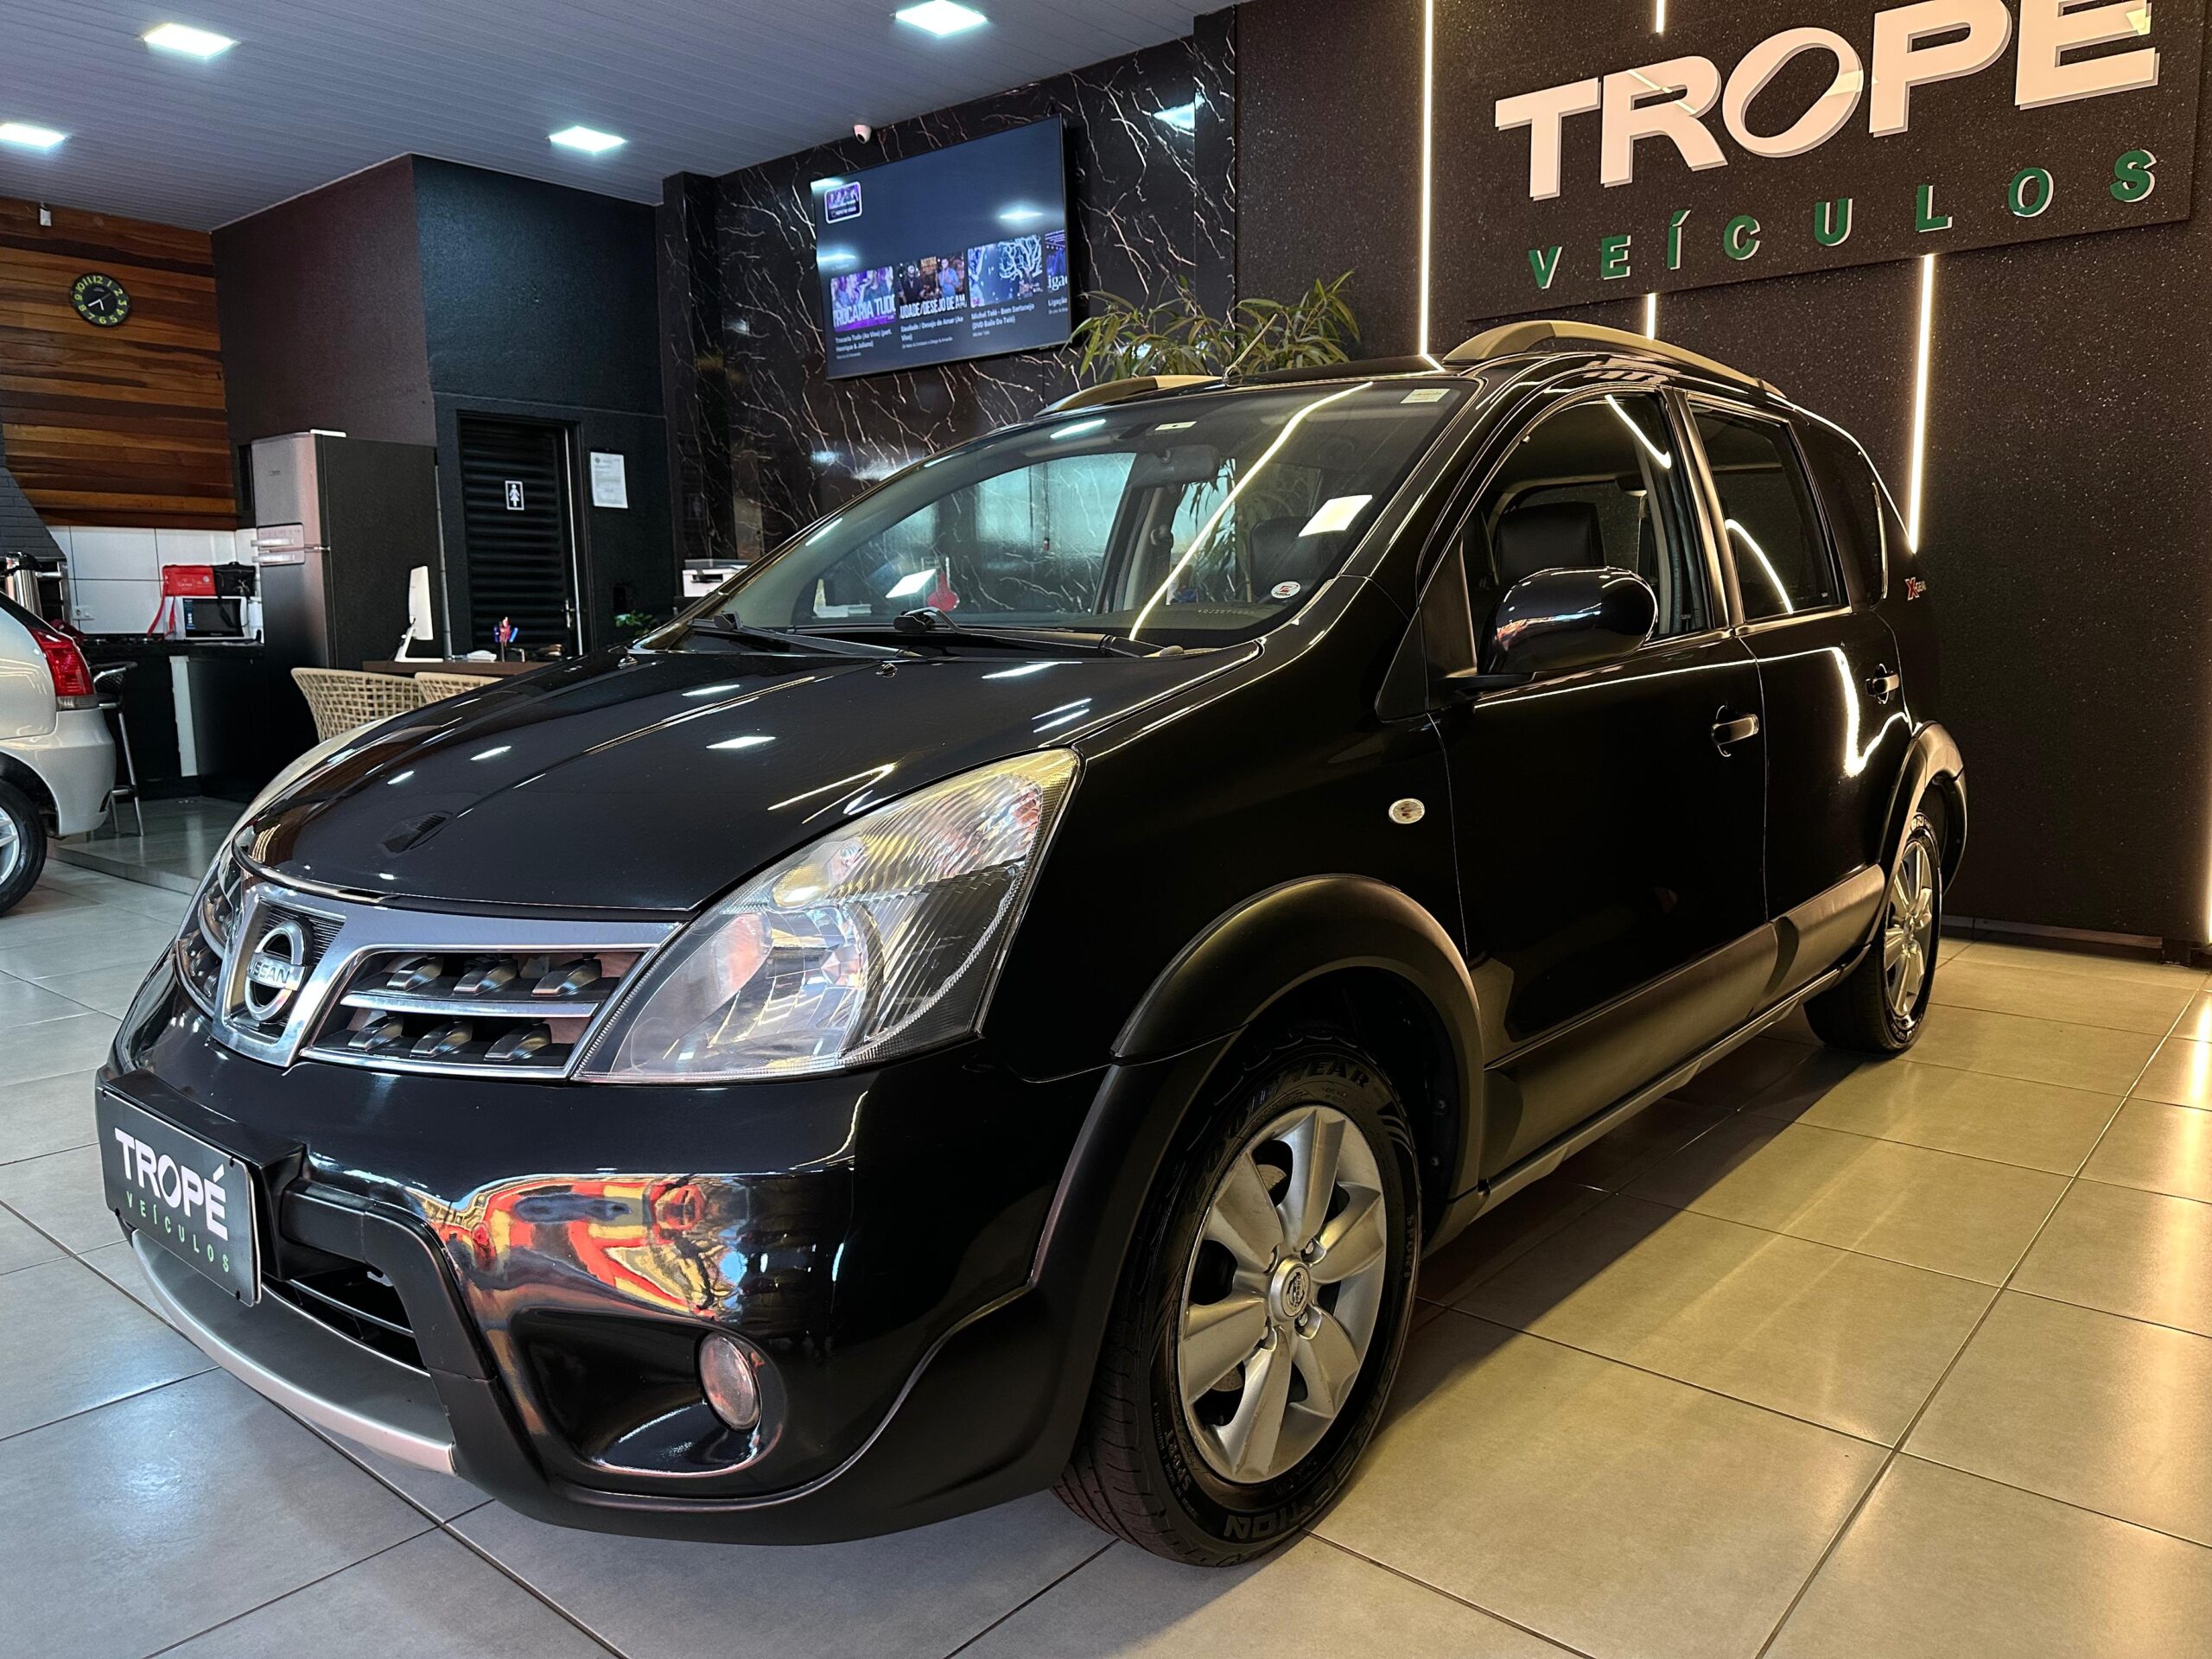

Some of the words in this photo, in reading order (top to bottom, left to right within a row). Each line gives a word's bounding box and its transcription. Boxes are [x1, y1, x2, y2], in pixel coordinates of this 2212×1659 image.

[1529, 149, 2158, 289] VEÍCULOS
[82, 276, 92, 286] 11
[92, 275, 103, 284] 12
[75, 282, 86, 293] 10
[113, 288, 124, 296] 2
[78, 303, 87, 312] 8
[99, 315, 107, 324] 6
[109, 315, 118, 323] 5
[114, 1127, 228, 1241] TROPÉ
[125, 1190, 230, 1274] VEÍCULOS
